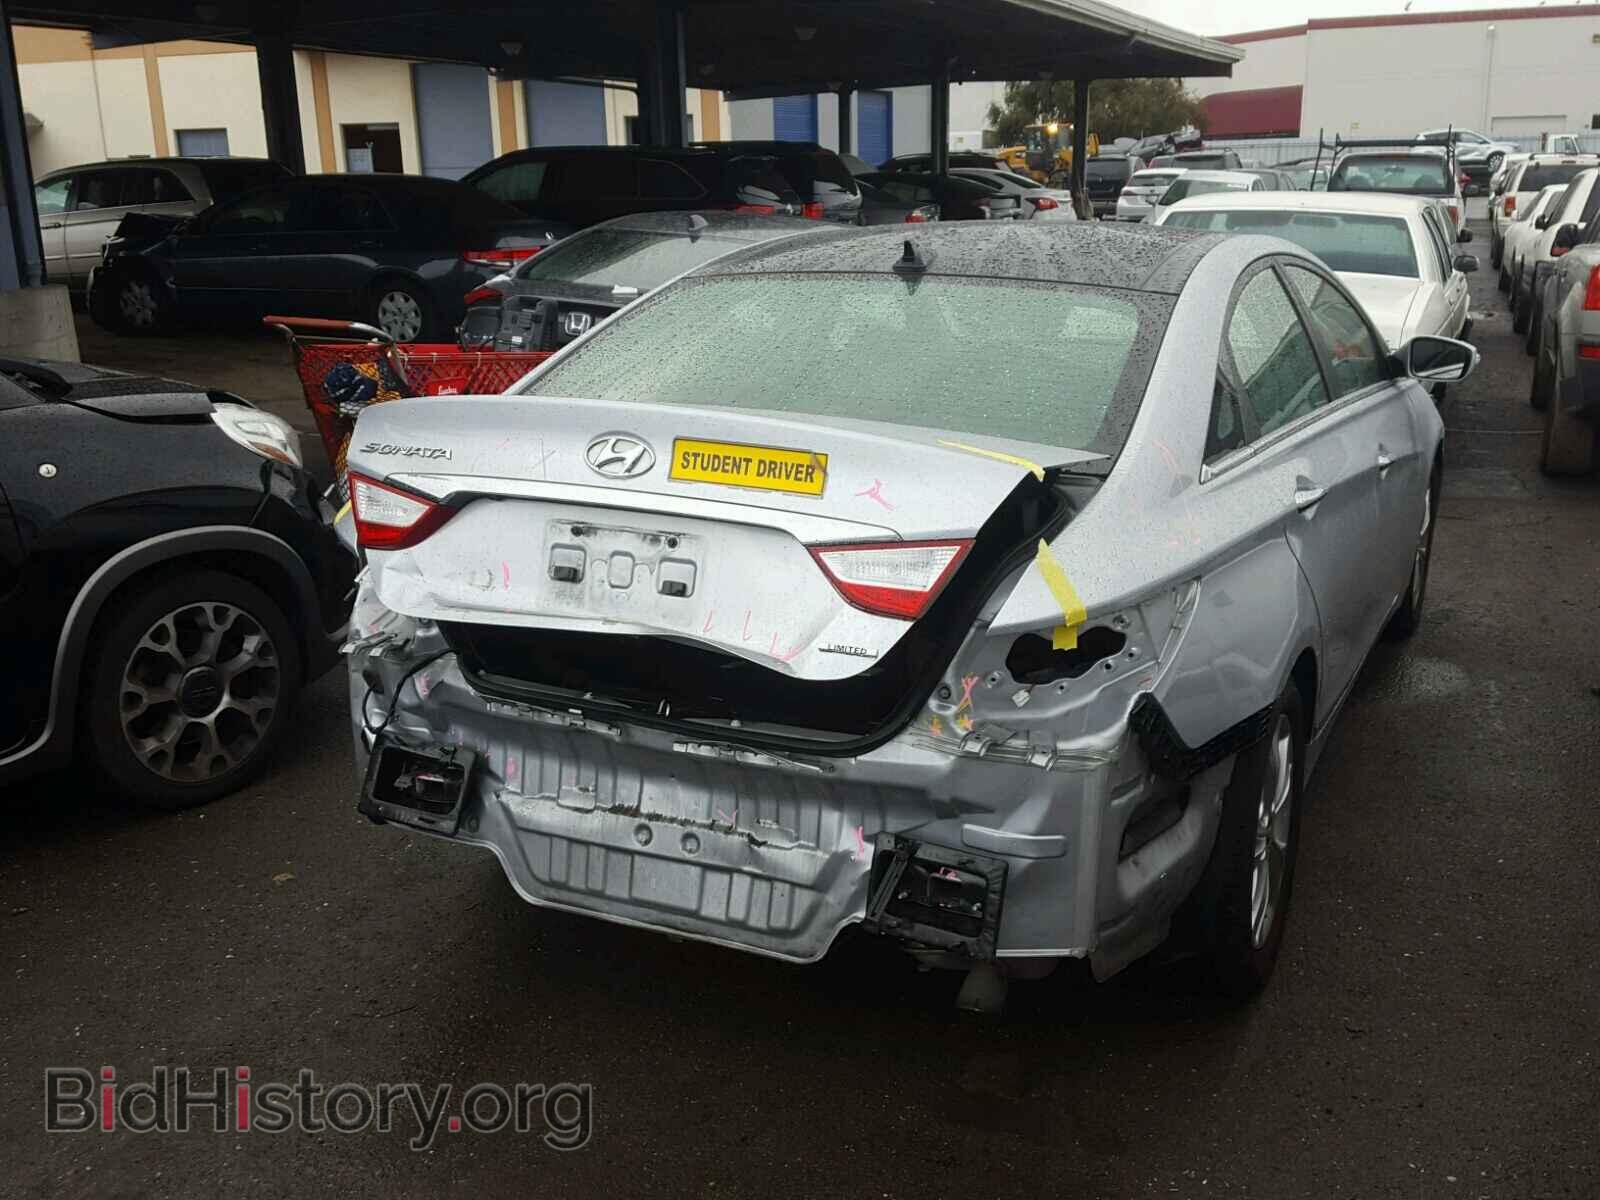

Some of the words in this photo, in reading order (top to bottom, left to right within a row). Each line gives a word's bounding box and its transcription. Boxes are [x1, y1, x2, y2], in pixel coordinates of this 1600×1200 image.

[360, 442, 453, 461] SONATA
[681, 451, 753, 476] STUDENT
[756, 458, 816, 483] DRIVER
[827, 643, 868, 656] LIMITED
